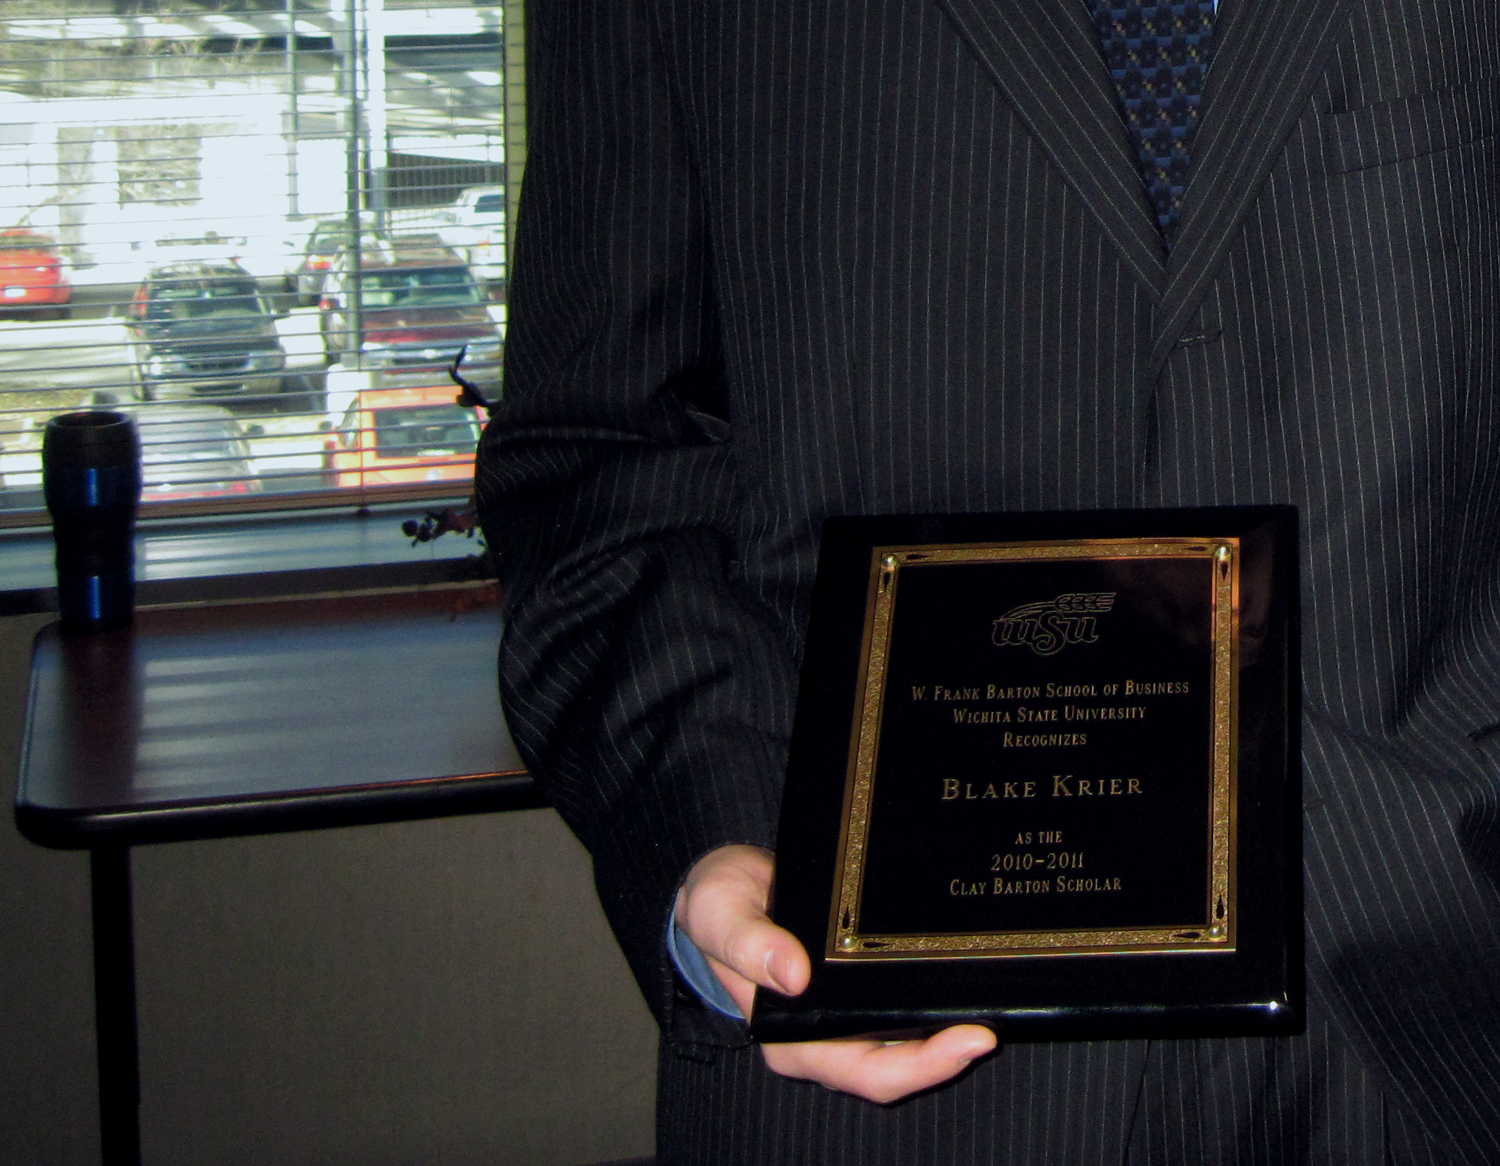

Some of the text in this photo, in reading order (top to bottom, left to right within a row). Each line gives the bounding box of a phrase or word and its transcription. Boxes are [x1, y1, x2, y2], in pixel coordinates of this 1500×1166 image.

[912, 679, 1189, 701] W. FRANK BARTON SCHOOL OF BUSINESS
[952, 705, 1147, 723] WICHITA STATE UNIVERSITY
[1003, 732, 1087, 748] RECOGNIZES
[942, 775, 1143, 800] BLAKE KRIER
[1015, 831, 1062, 845] AS THE
[991, 852, 1084, 870] 2010-2011
[949, 875, 1122, 896] CLAY BARTON SCHOLAR
